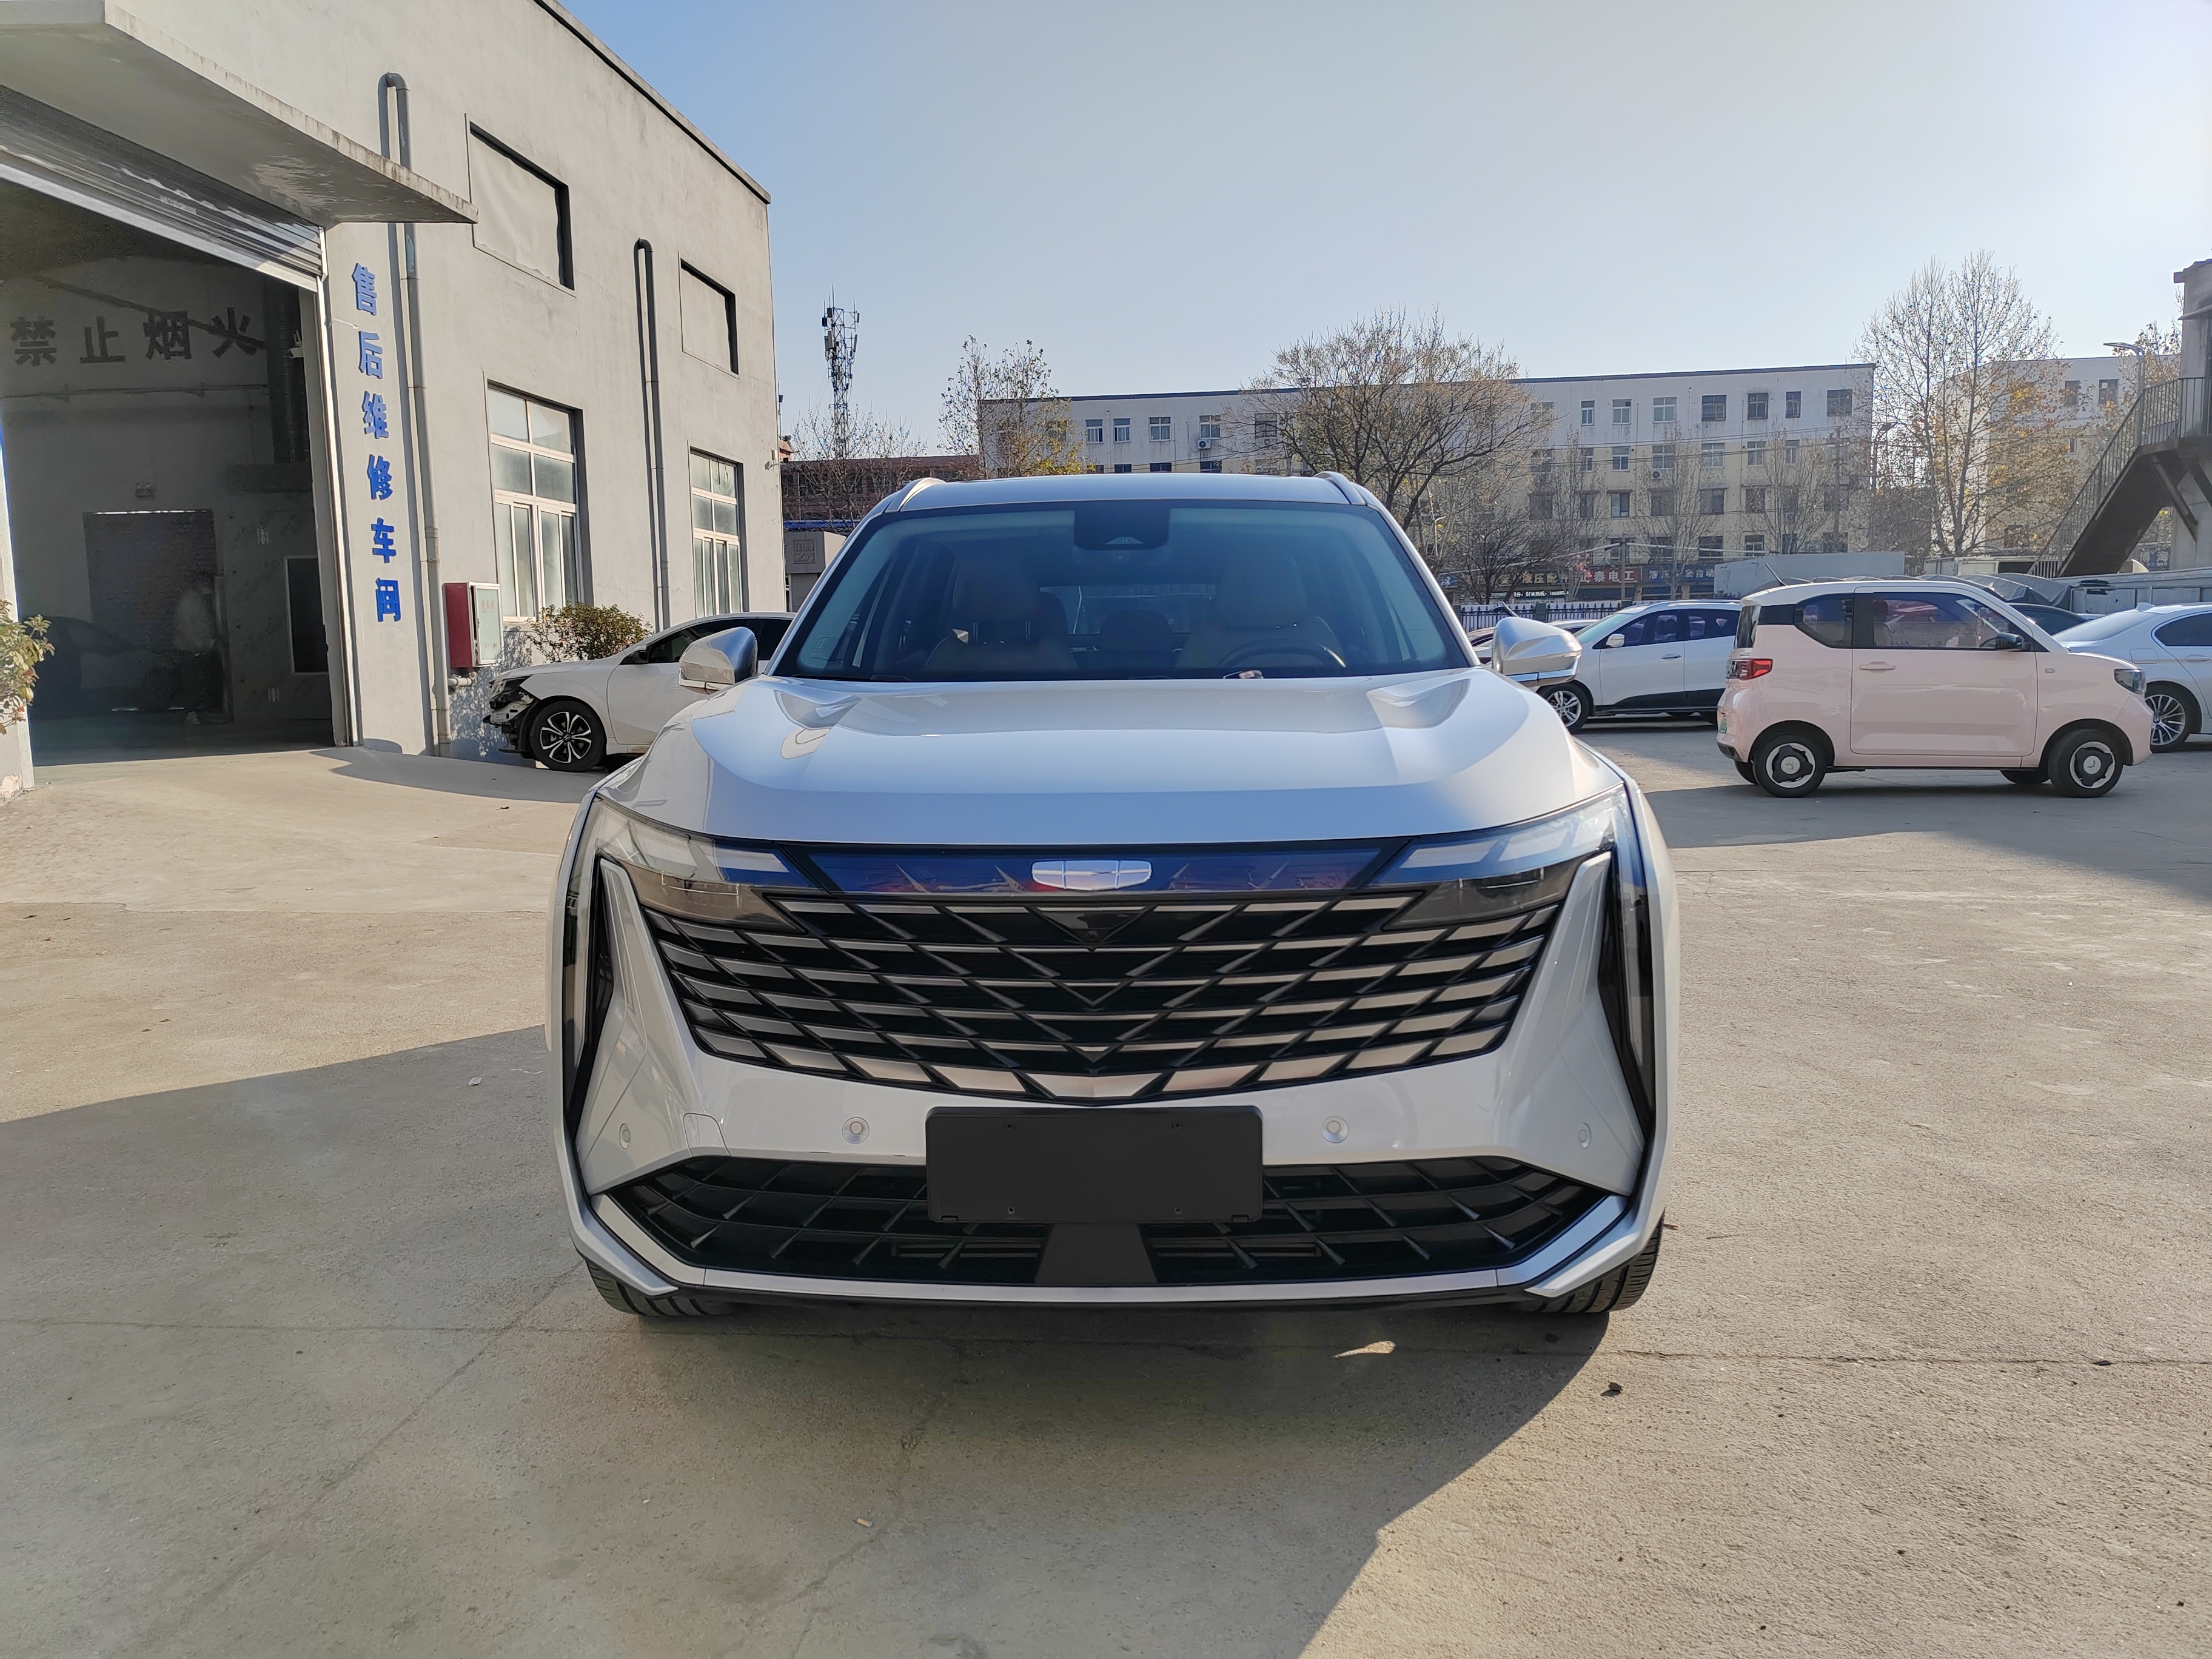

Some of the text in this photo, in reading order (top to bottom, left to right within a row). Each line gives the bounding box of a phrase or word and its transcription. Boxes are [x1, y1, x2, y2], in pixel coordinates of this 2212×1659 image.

[10, 307, 264, 366] 禁止烟火
[352, 263, 401, 622] 售后维修车间
